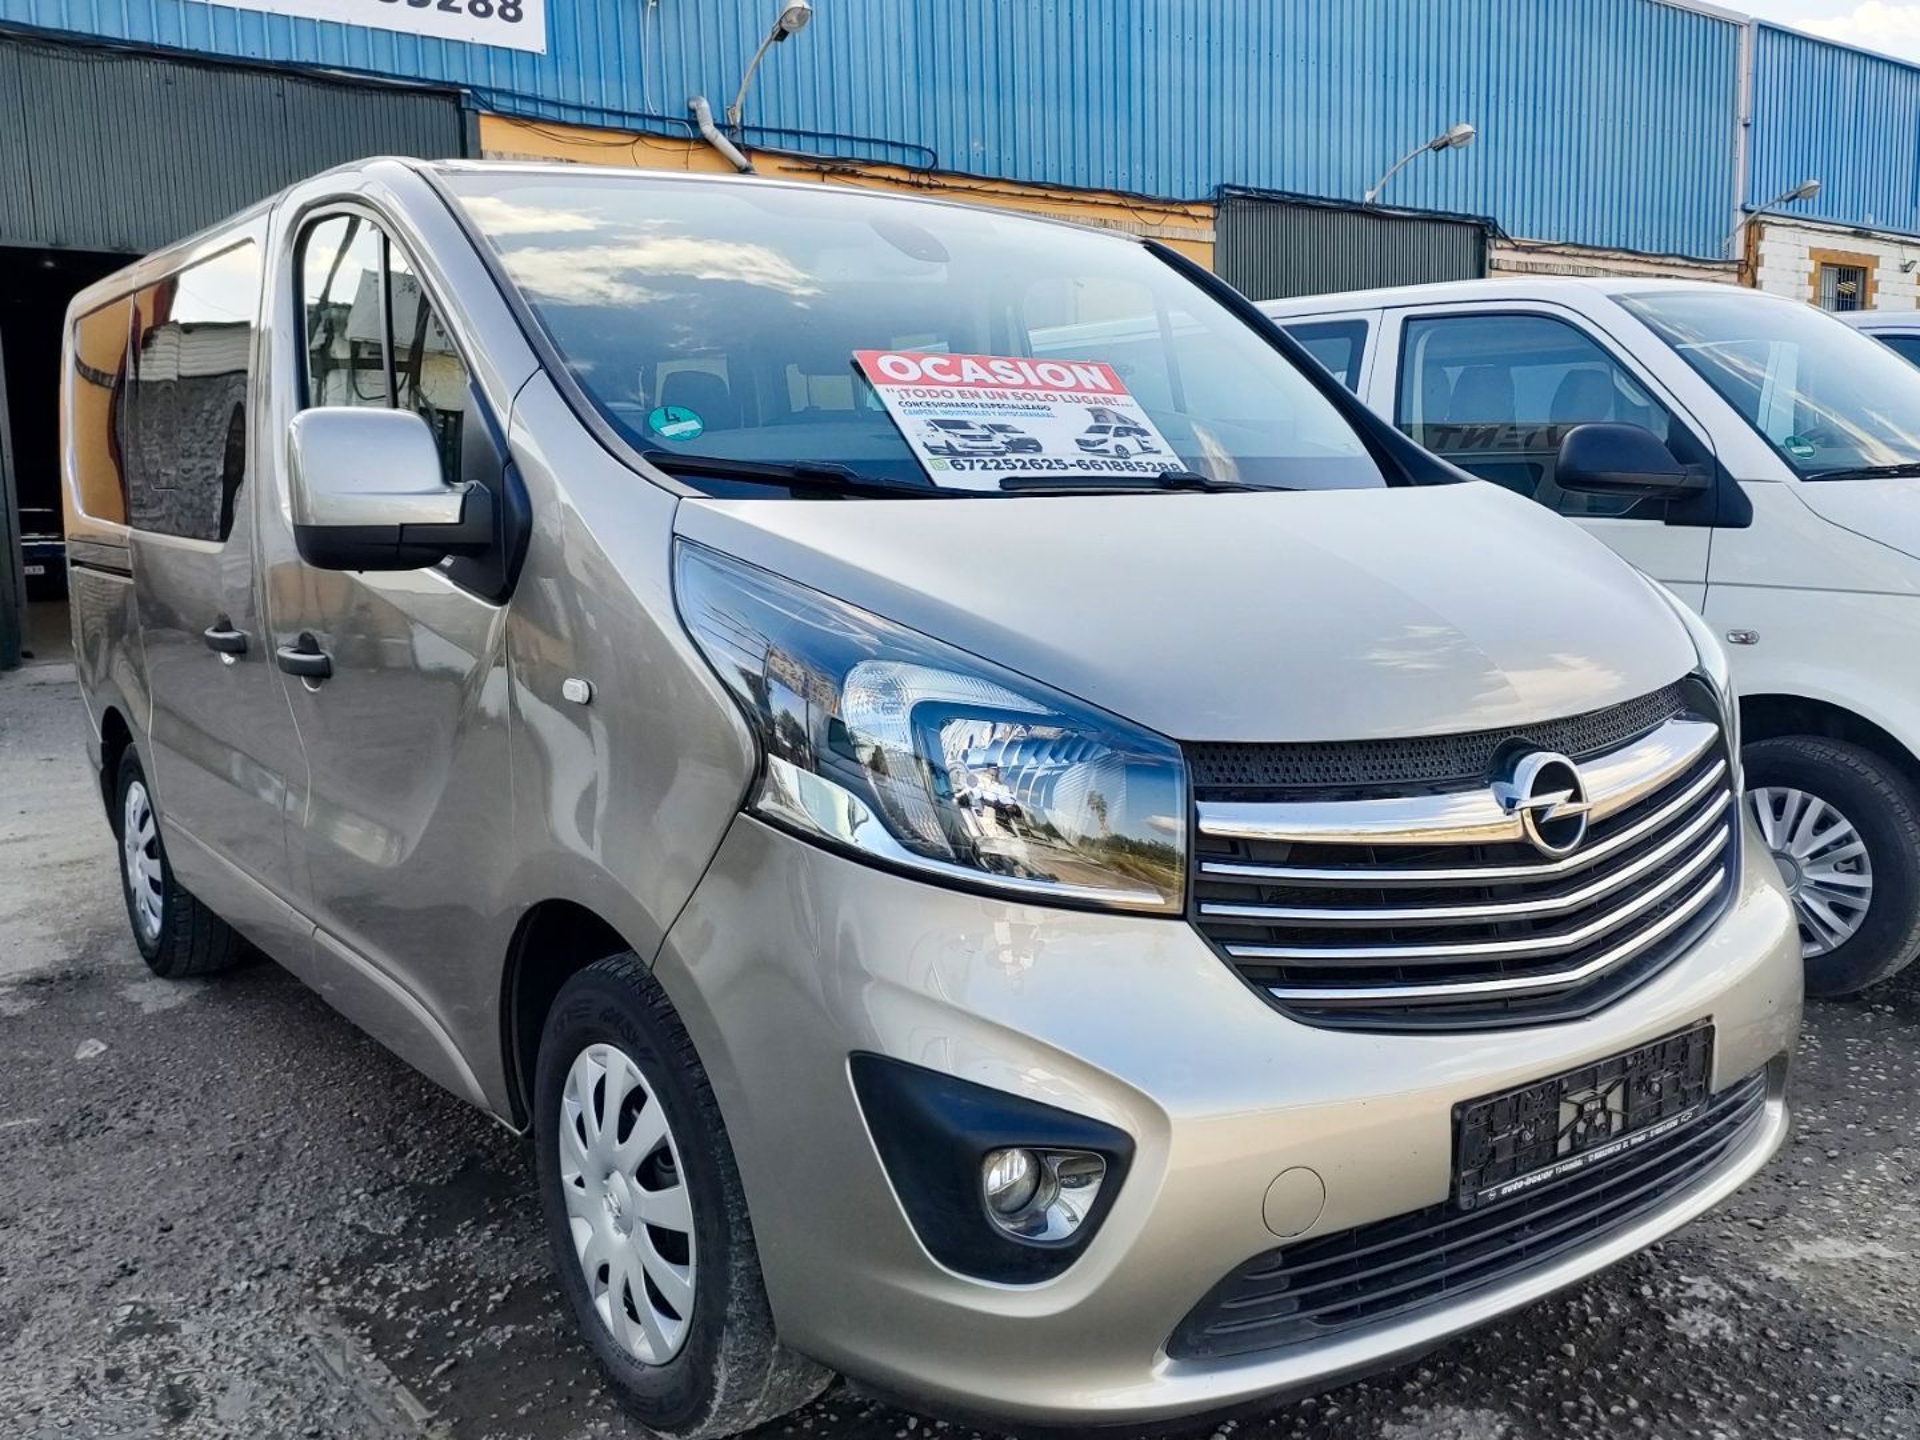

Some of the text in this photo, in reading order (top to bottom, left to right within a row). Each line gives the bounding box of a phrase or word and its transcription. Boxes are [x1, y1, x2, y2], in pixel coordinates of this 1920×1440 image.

[877, 354, 1113, 391] OCASION
[957, 390, 981, 400] EN
[983, 391, 1010, 400] UN
[1011, 392, 1058, 402] SOLO
[898, 401, 1051, 411] CONCESIONARIO ESPECIALIZADO
